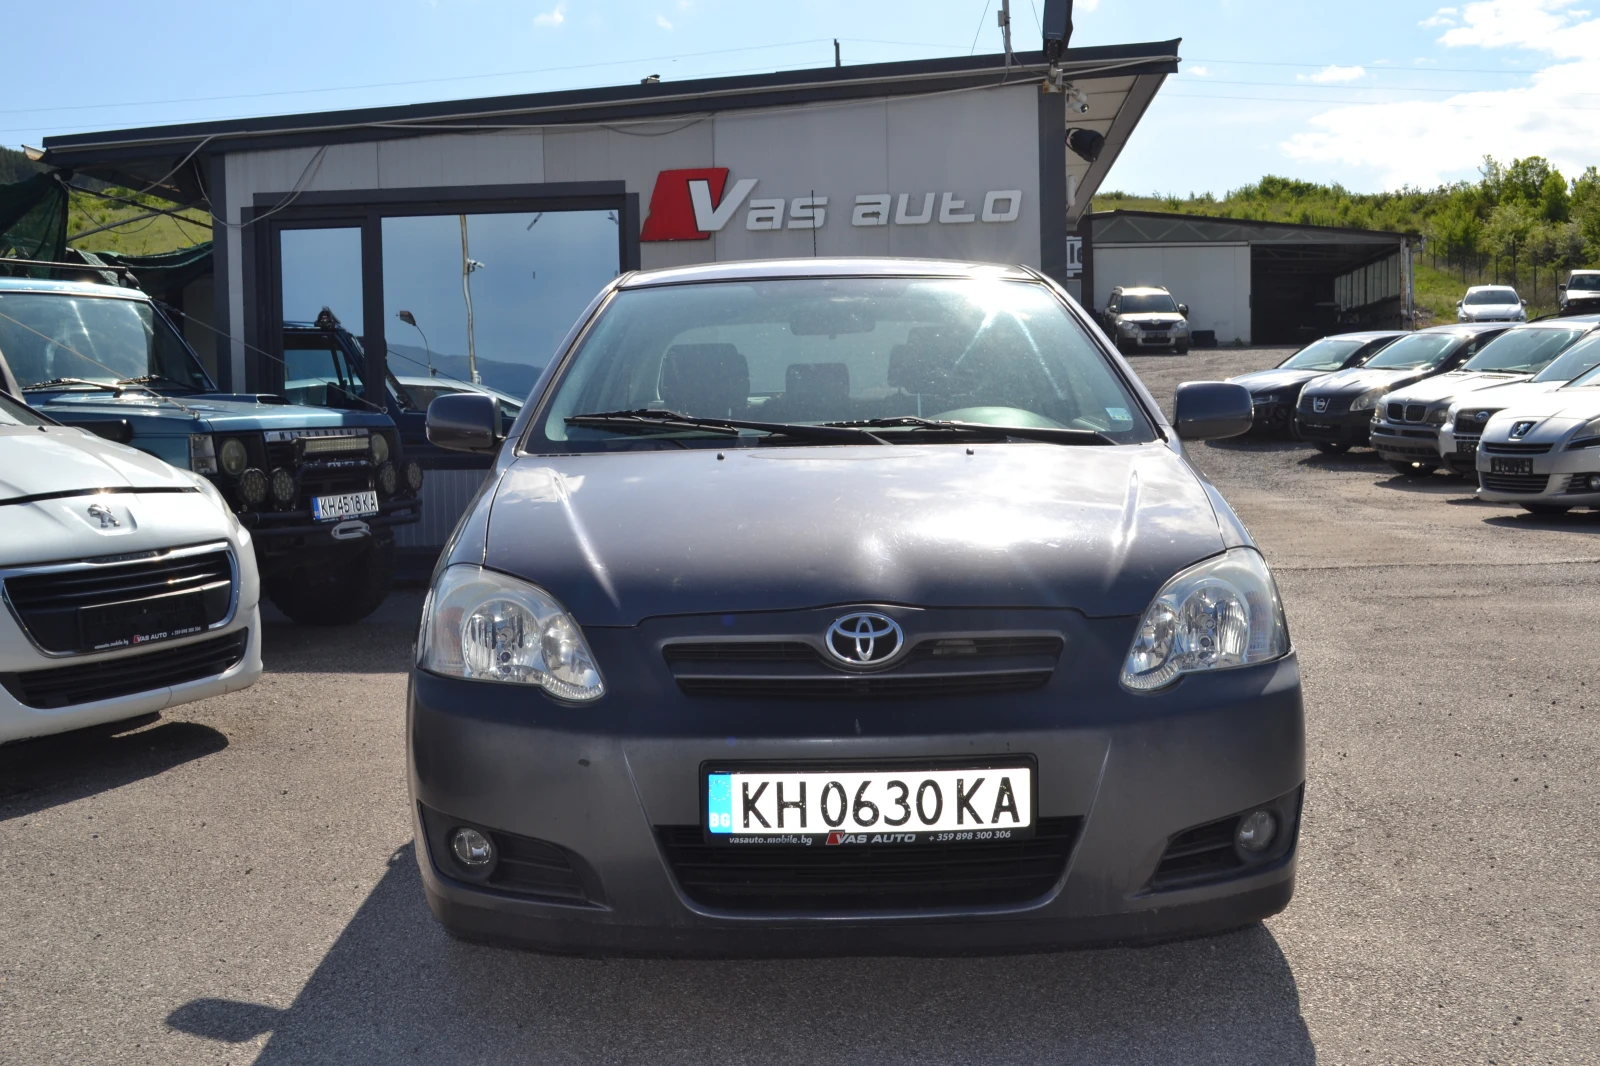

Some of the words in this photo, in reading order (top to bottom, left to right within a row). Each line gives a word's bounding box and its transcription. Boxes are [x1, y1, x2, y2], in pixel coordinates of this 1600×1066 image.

[851, 189, 1022, 227] auto
[320, 498, 336, 517] KH
[337, 494, 362, 513] 4518
[362, 493, 376, 511] KA
[137, 634, 149, 642] VAS
[150, 631, 168, 640] AUTO
[742, 781, 807, 828] KH
[820, 779, 943, 828] 0630
[956, 776, 1020, 825] KA
[709, 812, 731, 828] BG
[729, 834, 813, 846] vasauto.mobile.bg
[835, 833, 867, 844] VAS
[870, 833, 916, 843] AUTO
[936, 832, 954, 841] 359
[955, 831, 973, 840] 898
[975, 831, 992, 839] 300
[993, 830, 1011, 839] 306
